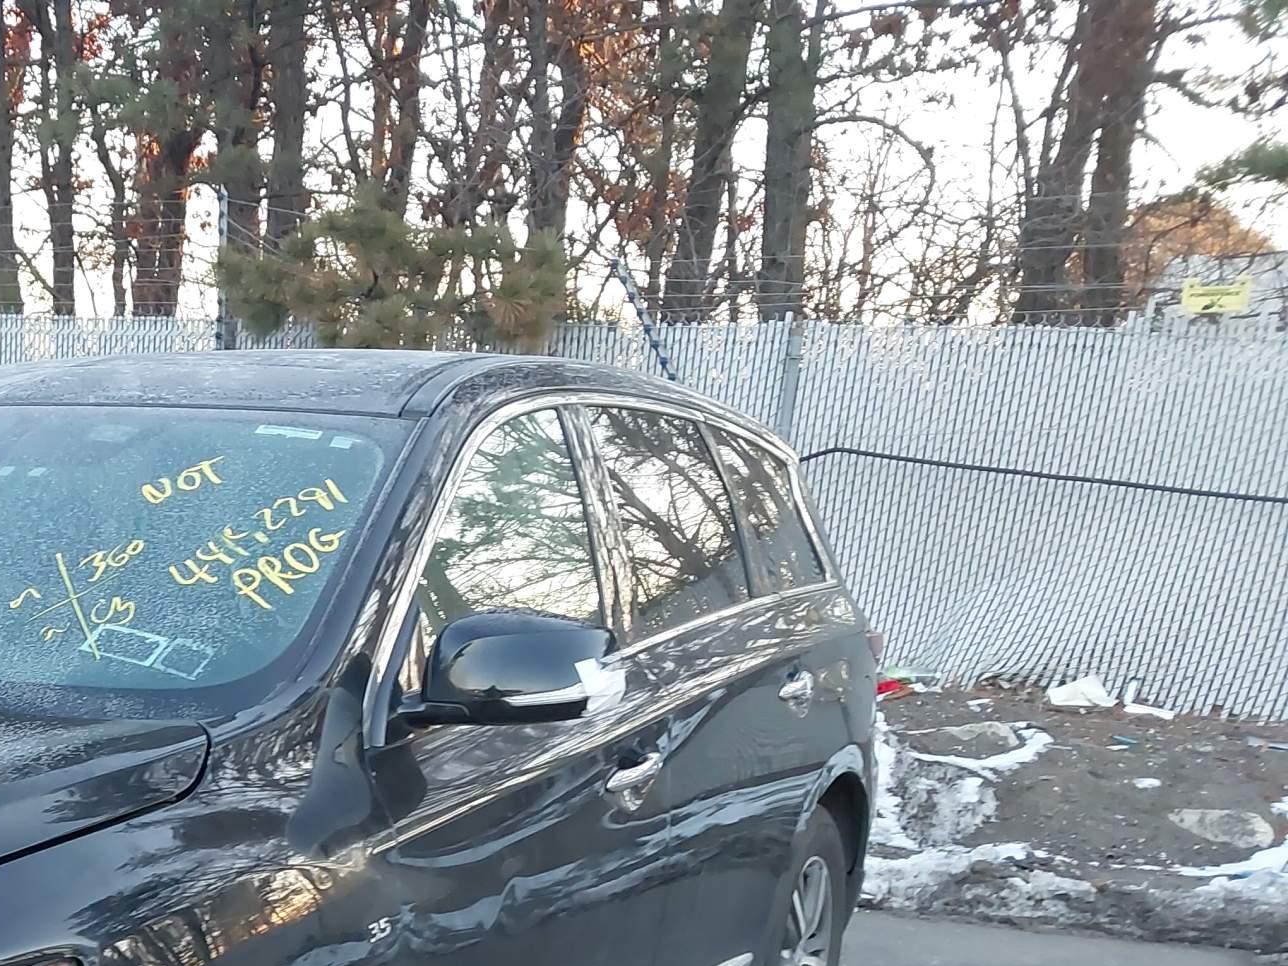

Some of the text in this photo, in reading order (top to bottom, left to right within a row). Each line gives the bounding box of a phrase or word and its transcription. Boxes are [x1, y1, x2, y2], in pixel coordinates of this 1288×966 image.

[141, 456, 225, 505] NOT
[78, 539, 145, 582] 360
[232, 527, 347, 610] PROG
